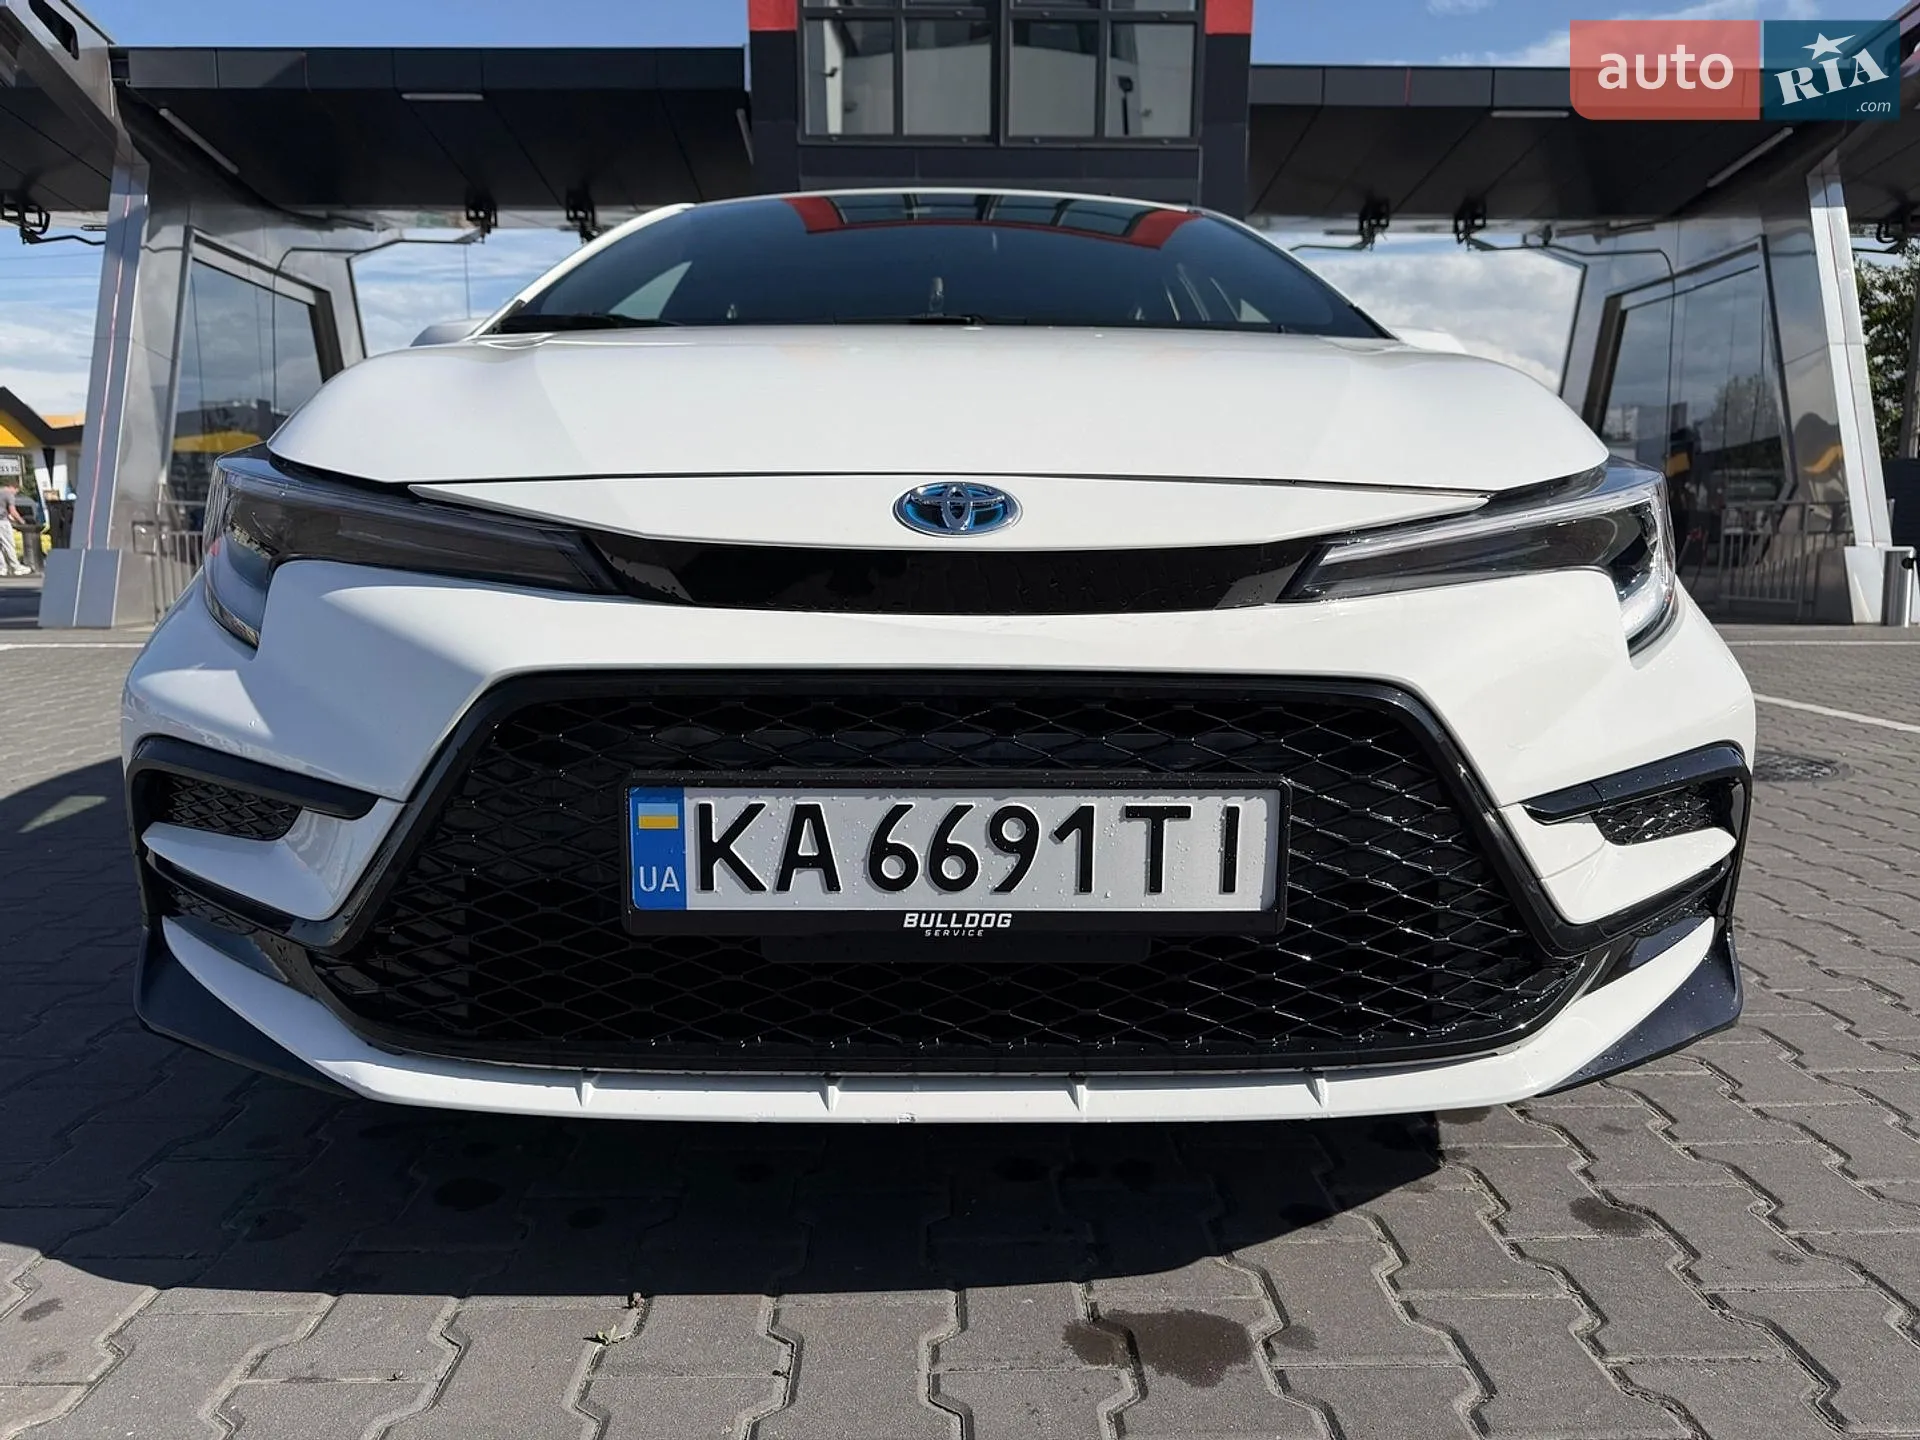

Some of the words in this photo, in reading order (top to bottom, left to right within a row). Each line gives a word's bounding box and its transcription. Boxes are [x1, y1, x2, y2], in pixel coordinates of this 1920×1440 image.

[697, 802, 842, 893] KA
[868, 803, 1096, 894] 6691
[1123, 804, 1241, 894] TI
[639, 866, 680, 892] UA
[903, 912, 1012, 928] BULLDOG
[924, 929, 984, 937] SERVICE
